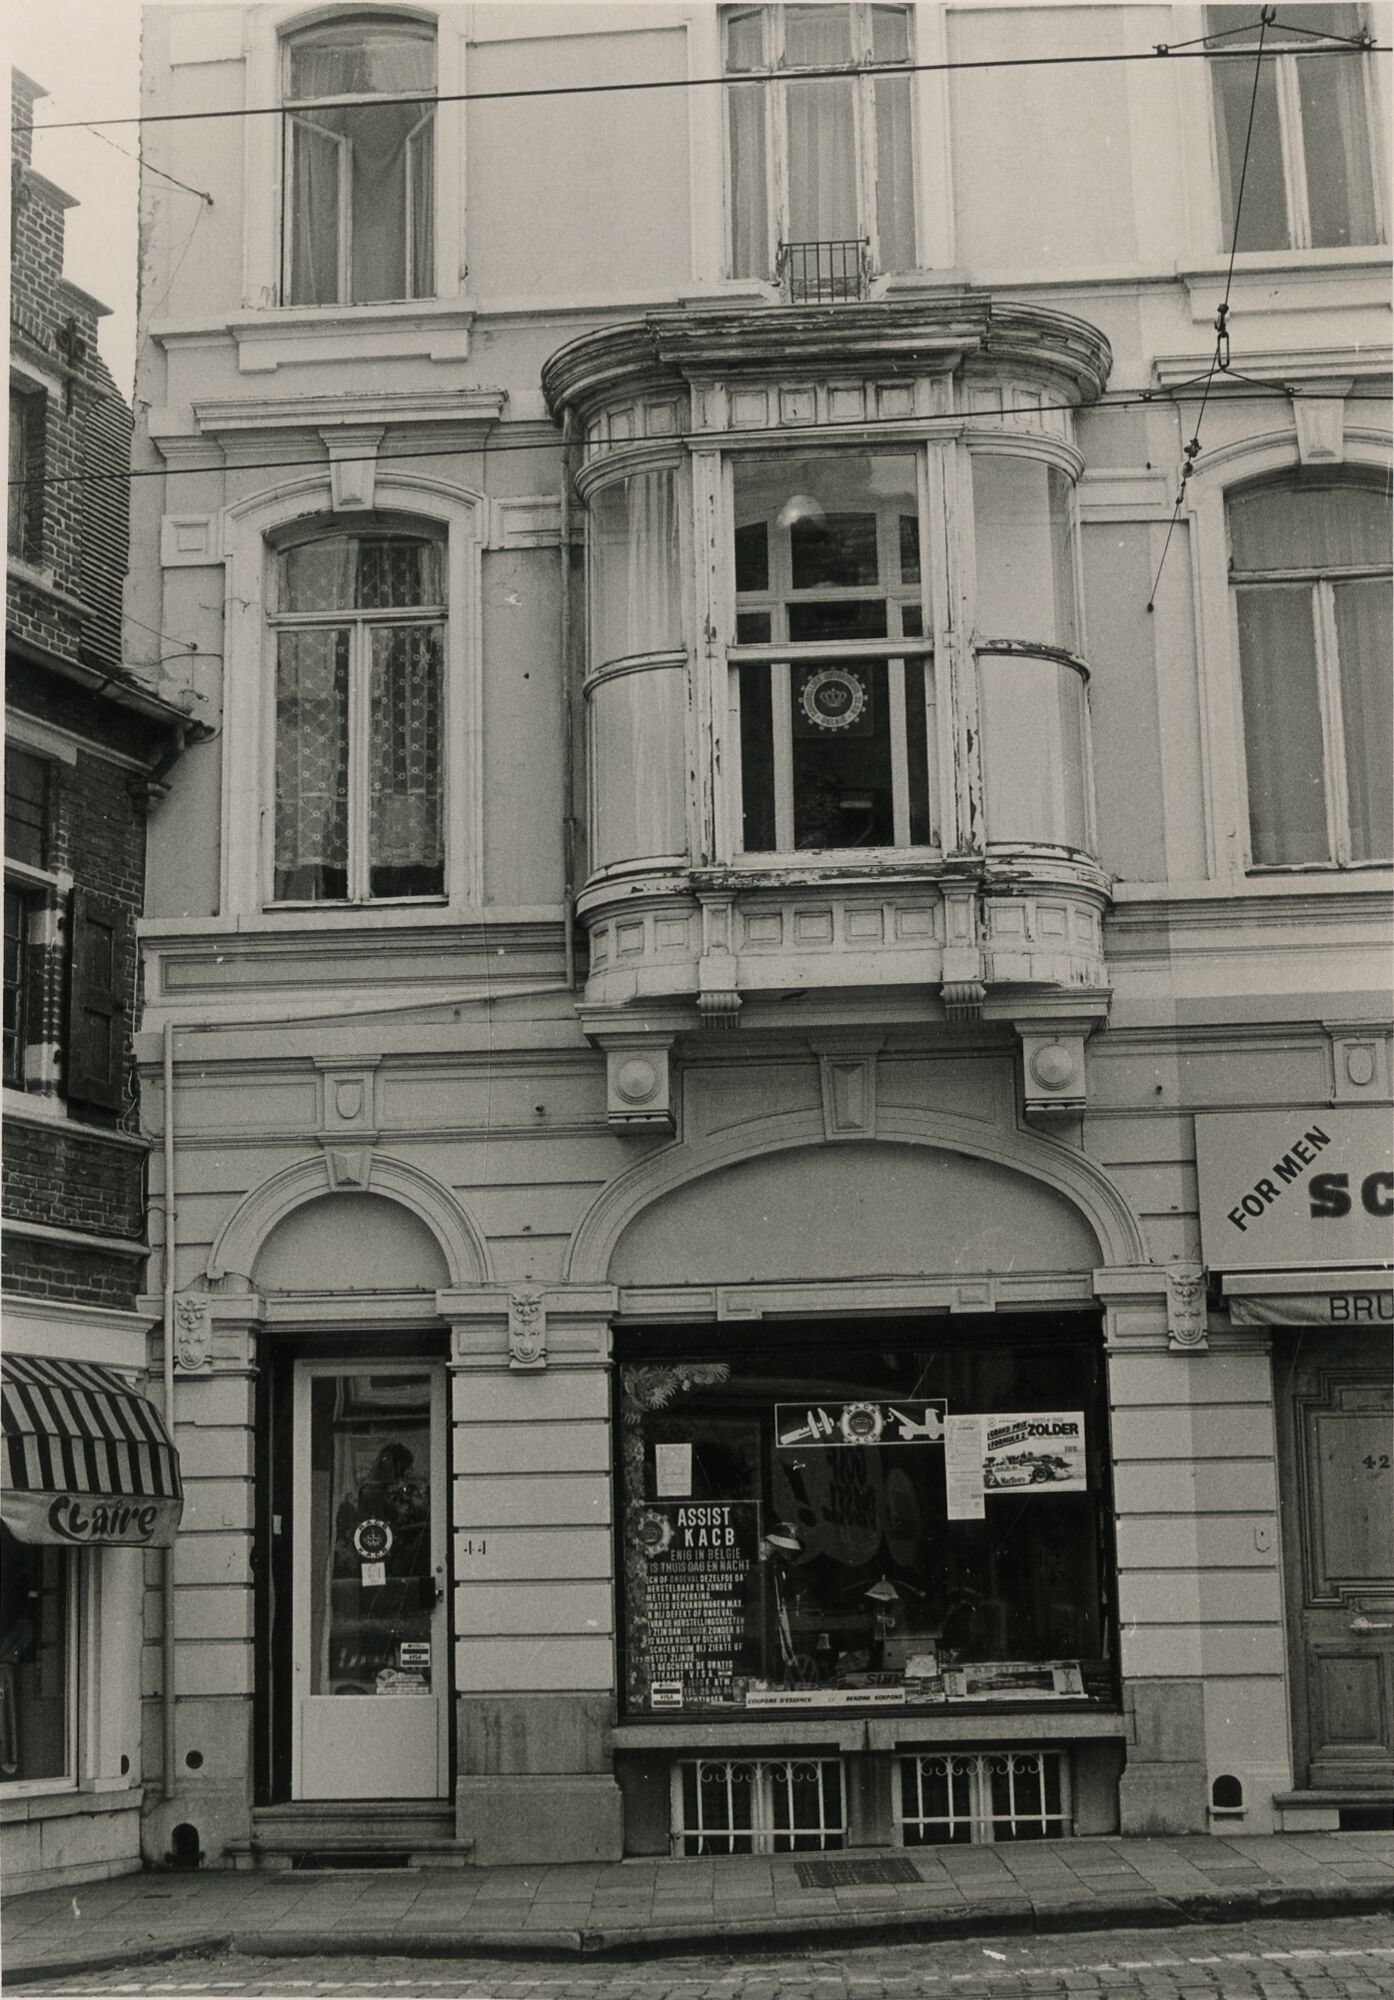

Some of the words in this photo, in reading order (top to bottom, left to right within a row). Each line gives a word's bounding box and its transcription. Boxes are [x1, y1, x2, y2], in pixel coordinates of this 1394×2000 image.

[1227, 1178, 1281, 1232] FOR
[1272, 1125, 1331, 1185] MEN
[990, 1425, 1010, 1437] GRAND
[1012, 1421, 1027, 1431] PRIX
[1027, 1423, 1079, 1436] ZOLDER
[991, 1434, 1019, 1447] FORMULA
[1362, 1455, 1391, 1469] 42
[989, 1476, 995, 1485] 2
[1000, 1476, 1025, 1484] Marlboro
[678, 1507, 731, 1527] ASSIST
[685, 1528, 735, 1547] KACB
[671, 1550, 692, 1561] ENIG
[695, 1549, 705, 1560] IN
[708, 1548, 741, 1560] BELGIE
[661, 1561, 686, 1573] THUIS
[688, 1561, 705, 1573] DAG
[707, 1561, 718, 1572] EN
[720, 1559, 750, 1572] NACHT
[659, 1575, 668, 1583] OF
[700, 1574, 733, 1583] DEZELFDE
[696, 1583, 705, 1591] EN
[706, 1582, 732, 1591] ZONDER
[671, 1600, 725, 1610] VERVANGWAGEN
[654, 1610, 664, 1619] BIJ
[666, 1609, 692, 1618] DEFEKT
[693, 1609, 702, 1617] OF
[703, 1608, 734, 1617] ONGEVAL
[664, 1619, 672, 1627] DE
[668, 1627, 681, 1636] DAN
[708, 1626, 734, 1635] ZONDER
[655, 1636, 674, 1644] NAAR
[675, 1635, 691, 1644] HUIS
[692, 1635, 701, 1644] OF
[702, 1634, 731, 1643] DICHTER
[696, 1643, 706, 1652] BIJ
[708, 1643, 732, 1652] ZIEKTE
[734, 1642, 743, 1651] OF
[657, 1661, 694, 1671] GESCHENK
[696, 1660, 705, 1670] DE
[707, 1660, 733, 1669] GRATIS
